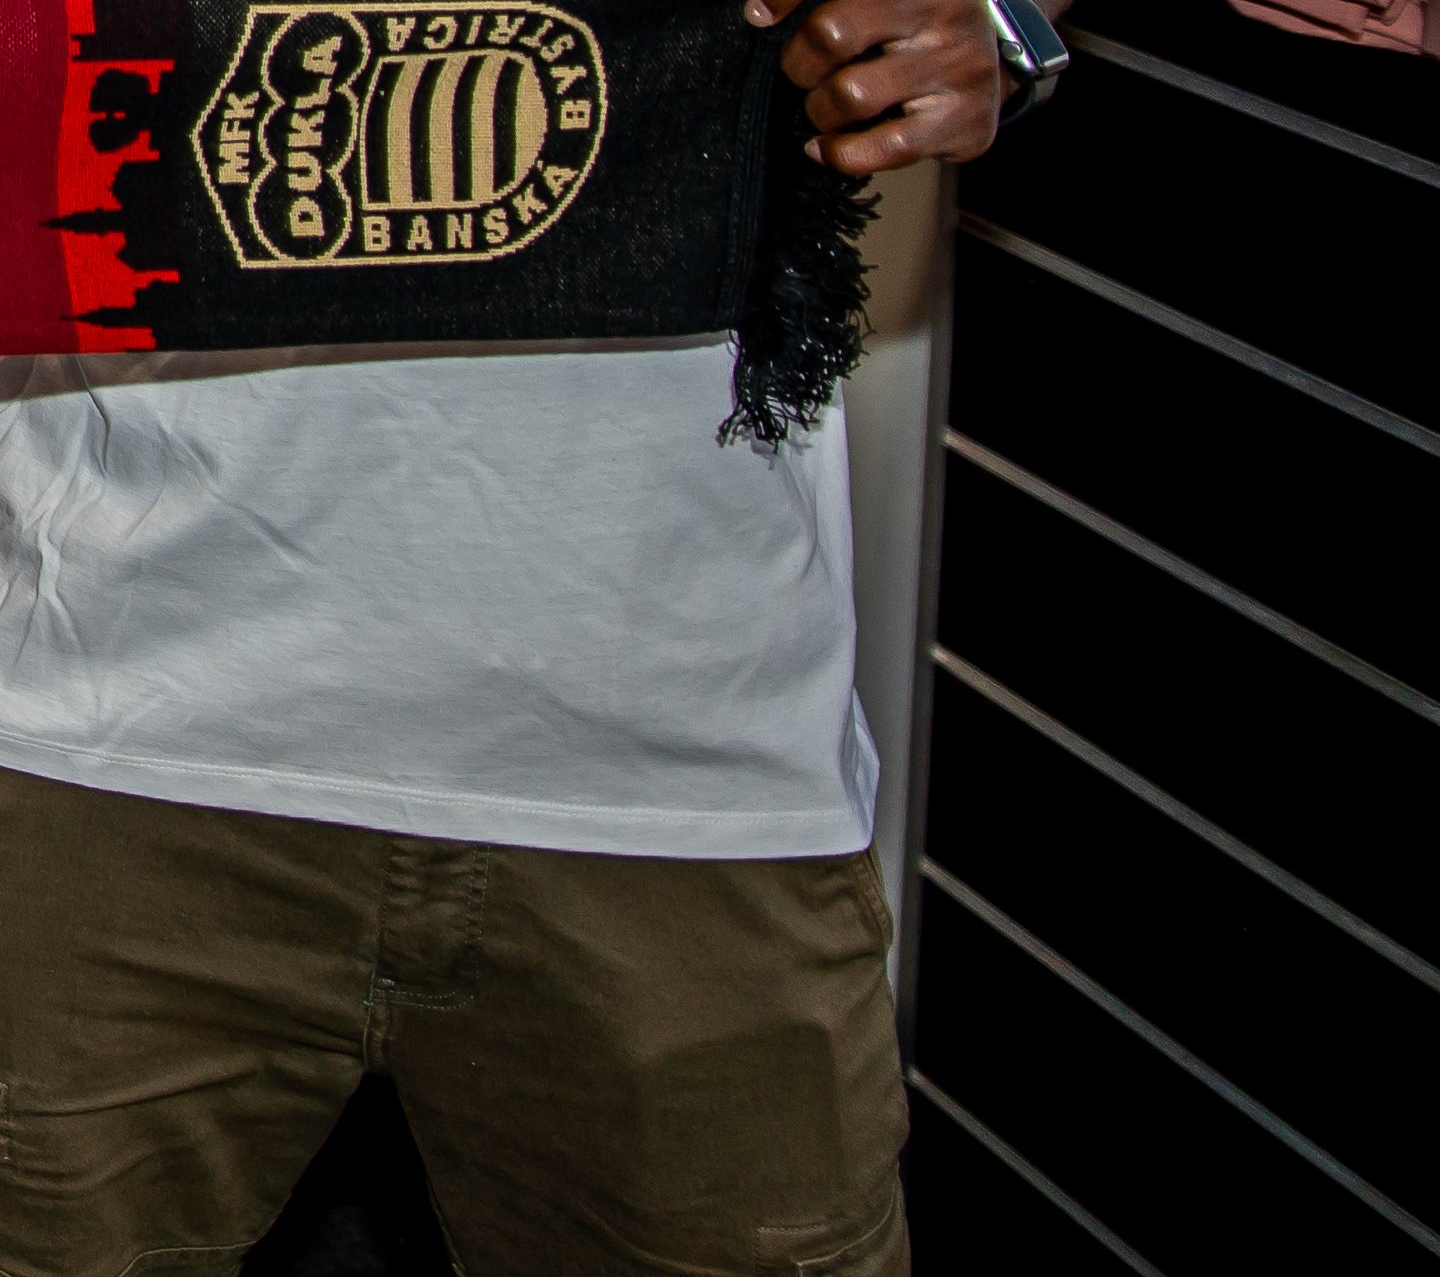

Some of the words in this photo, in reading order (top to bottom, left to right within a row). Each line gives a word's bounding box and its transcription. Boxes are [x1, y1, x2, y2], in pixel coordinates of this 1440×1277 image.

[385, 14, 593, 130] BYSTRICA
[218, 89, 260, 186] MFK
[286, 34, 344, 238] DUKLA
[364, 160, 580, 252] BANSKÁ
